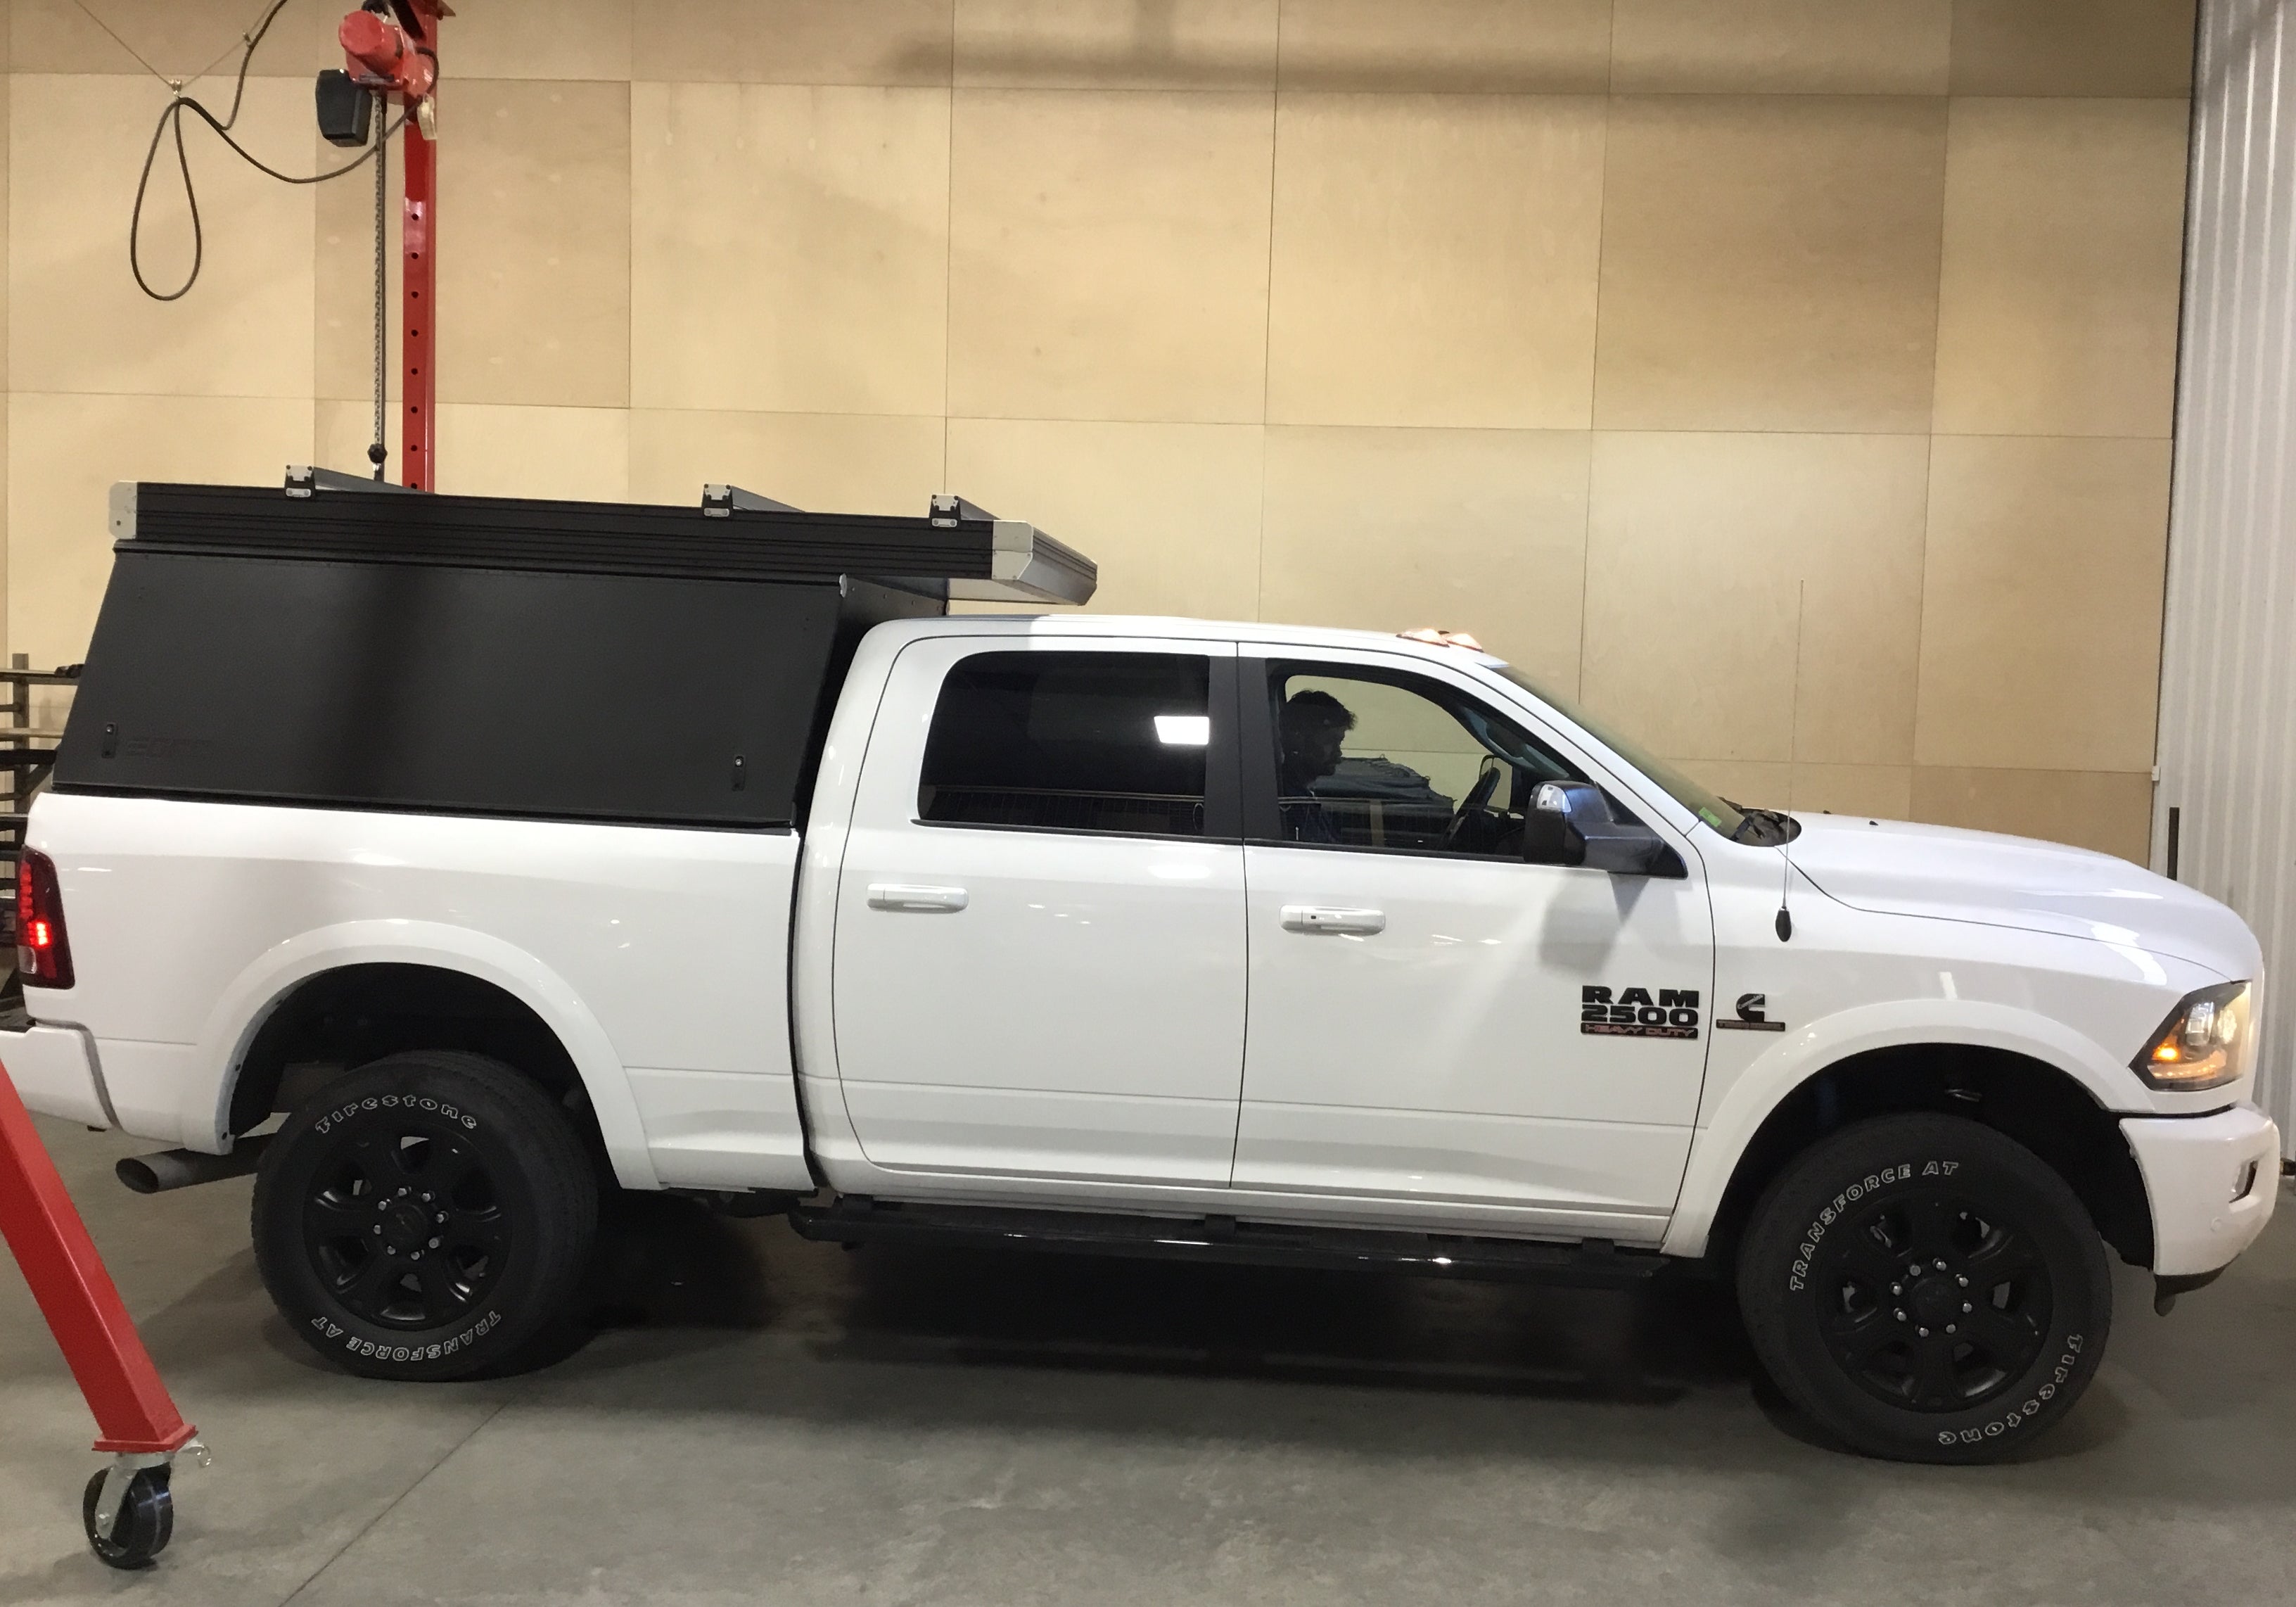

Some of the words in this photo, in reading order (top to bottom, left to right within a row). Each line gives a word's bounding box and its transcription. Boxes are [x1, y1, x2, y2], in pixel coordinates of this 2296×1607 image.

[1582, 985, 1699, 1008] RAM
[1581, 1004, 1699, 1026] 2500
[1585, 1024, 1644, 1034] HEAVY
[1645, 1027, 1695, 1037] DUTY
[1790, 1163, 1911, 1291] TRANSFORCE
[1922, 1161, 1959, 1176] AT
[311, 1316, 343, 1338] AT
[345, 1310, 502, 1361] TRANSFORCE
